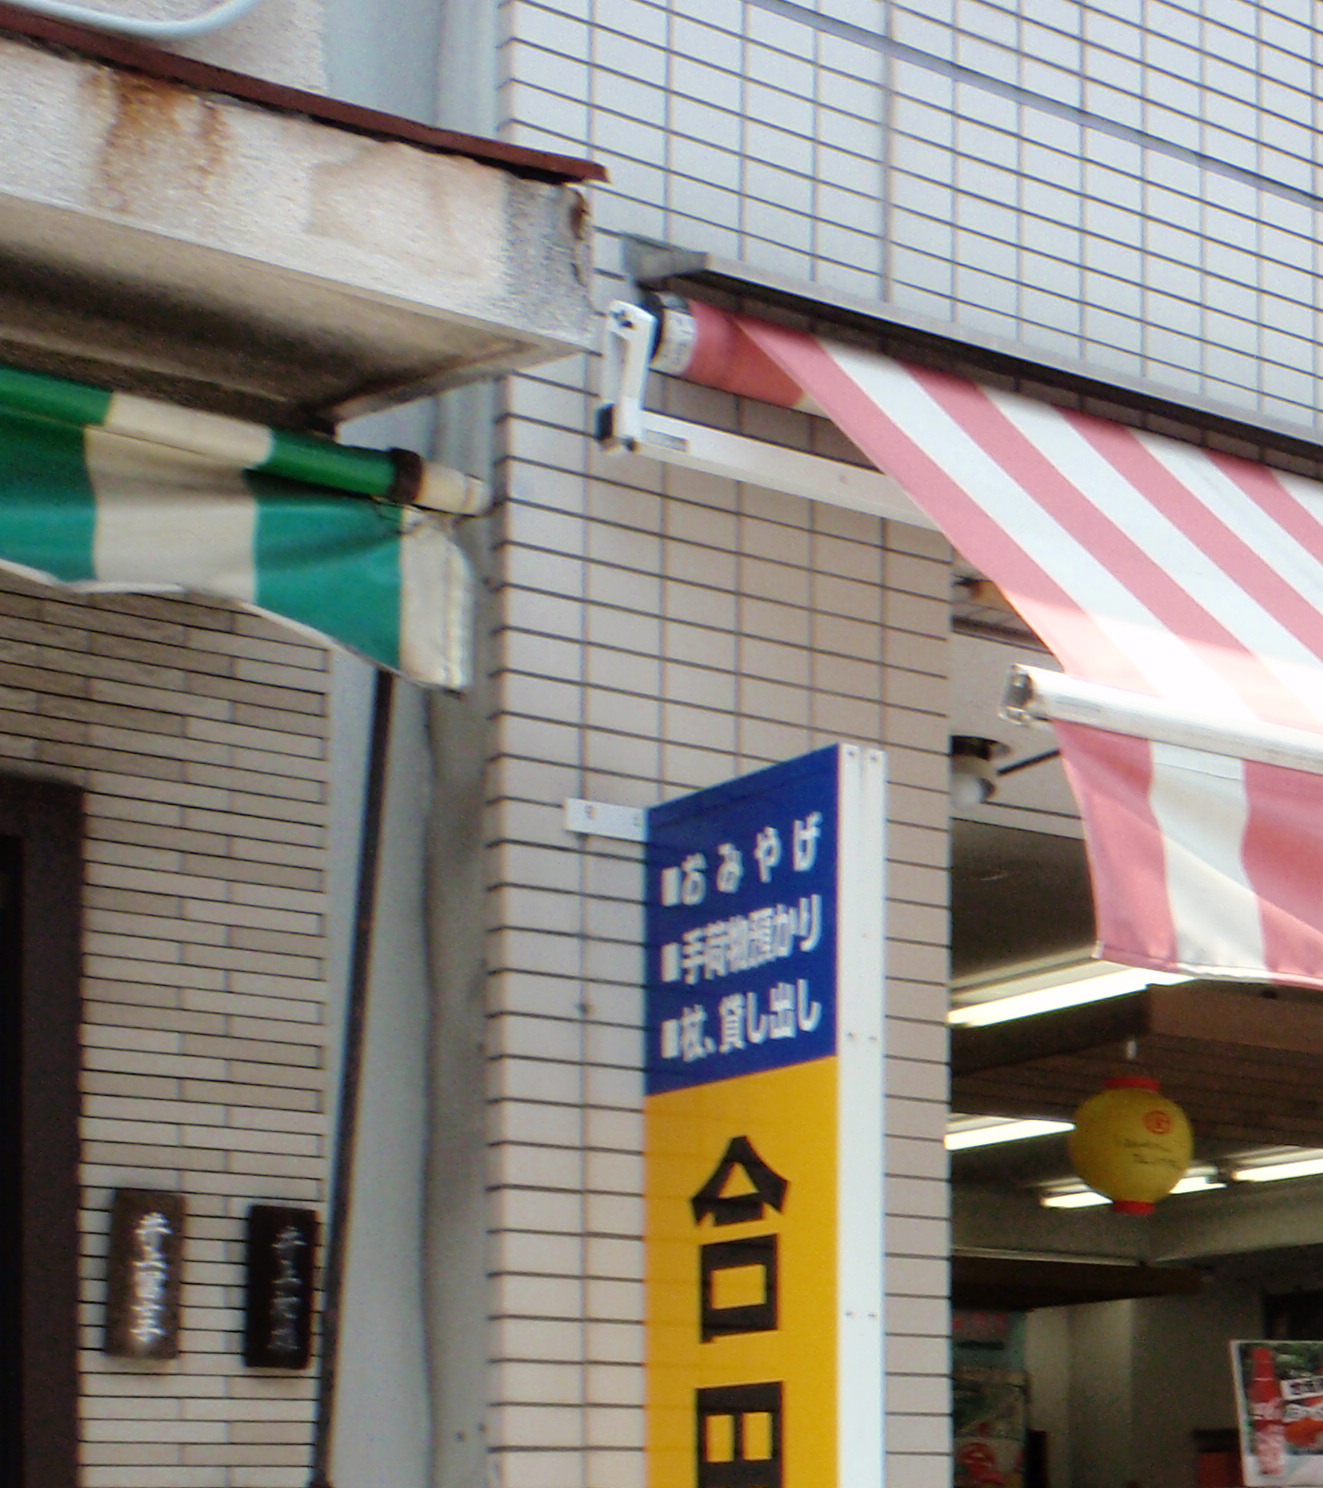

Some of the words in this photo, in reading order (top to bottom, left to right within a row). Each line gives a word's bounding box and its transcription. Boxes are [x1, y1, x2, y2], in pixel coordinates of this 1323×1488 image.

[681, 811, 823, 906] おみやげ
[681, 893, 823, 985] 手荷物預かり
